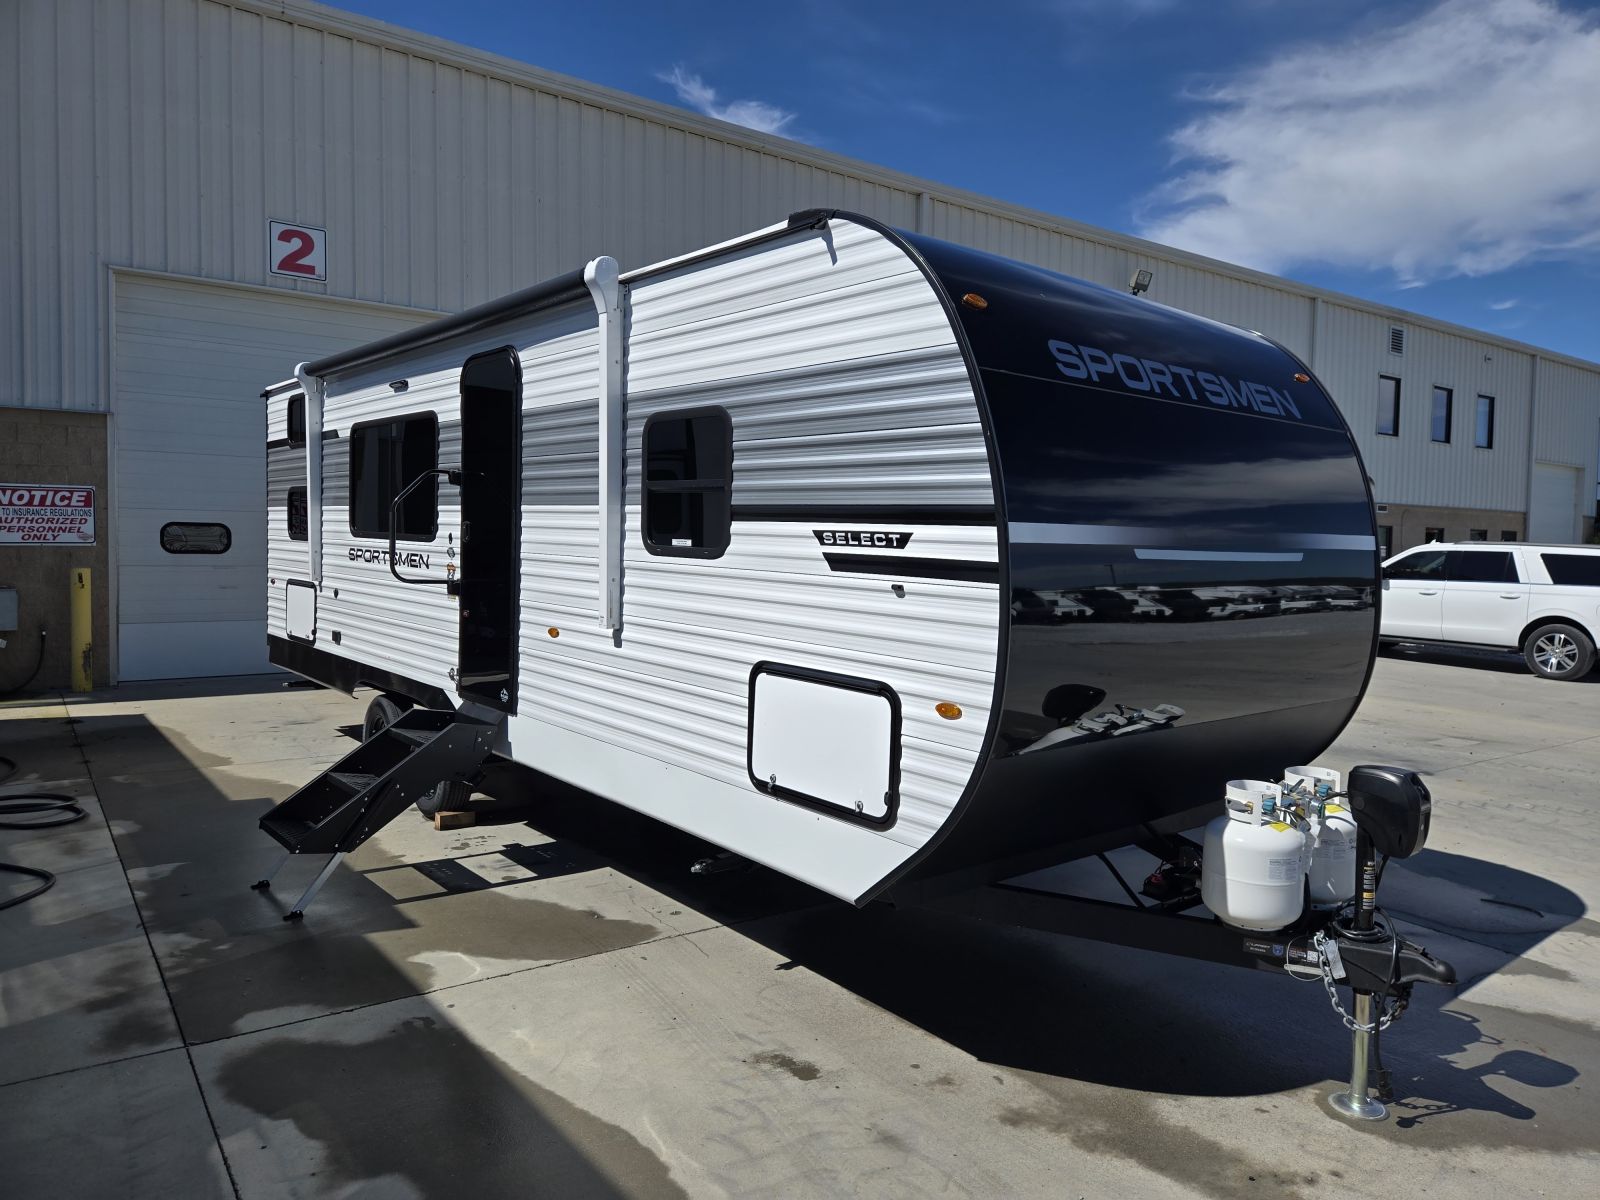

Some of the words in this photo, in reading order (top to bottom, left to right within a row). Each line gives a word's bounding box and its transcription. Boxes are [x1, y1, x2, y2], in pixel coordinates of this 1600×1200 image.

[277, 229, 316, 275] 2
[1048, 339, 1302, 419] SPORTSMEN
[0, 490, 86, 506] NOTICE
[2, 507, 11, 516] TO
[12, 508, 49, 517] INSURANCE
[50, 508, 92, 518] REGULATIONS
[0, 517, 88, 525] UTHORIZED
[822, 532, 901, 547] SELECT
